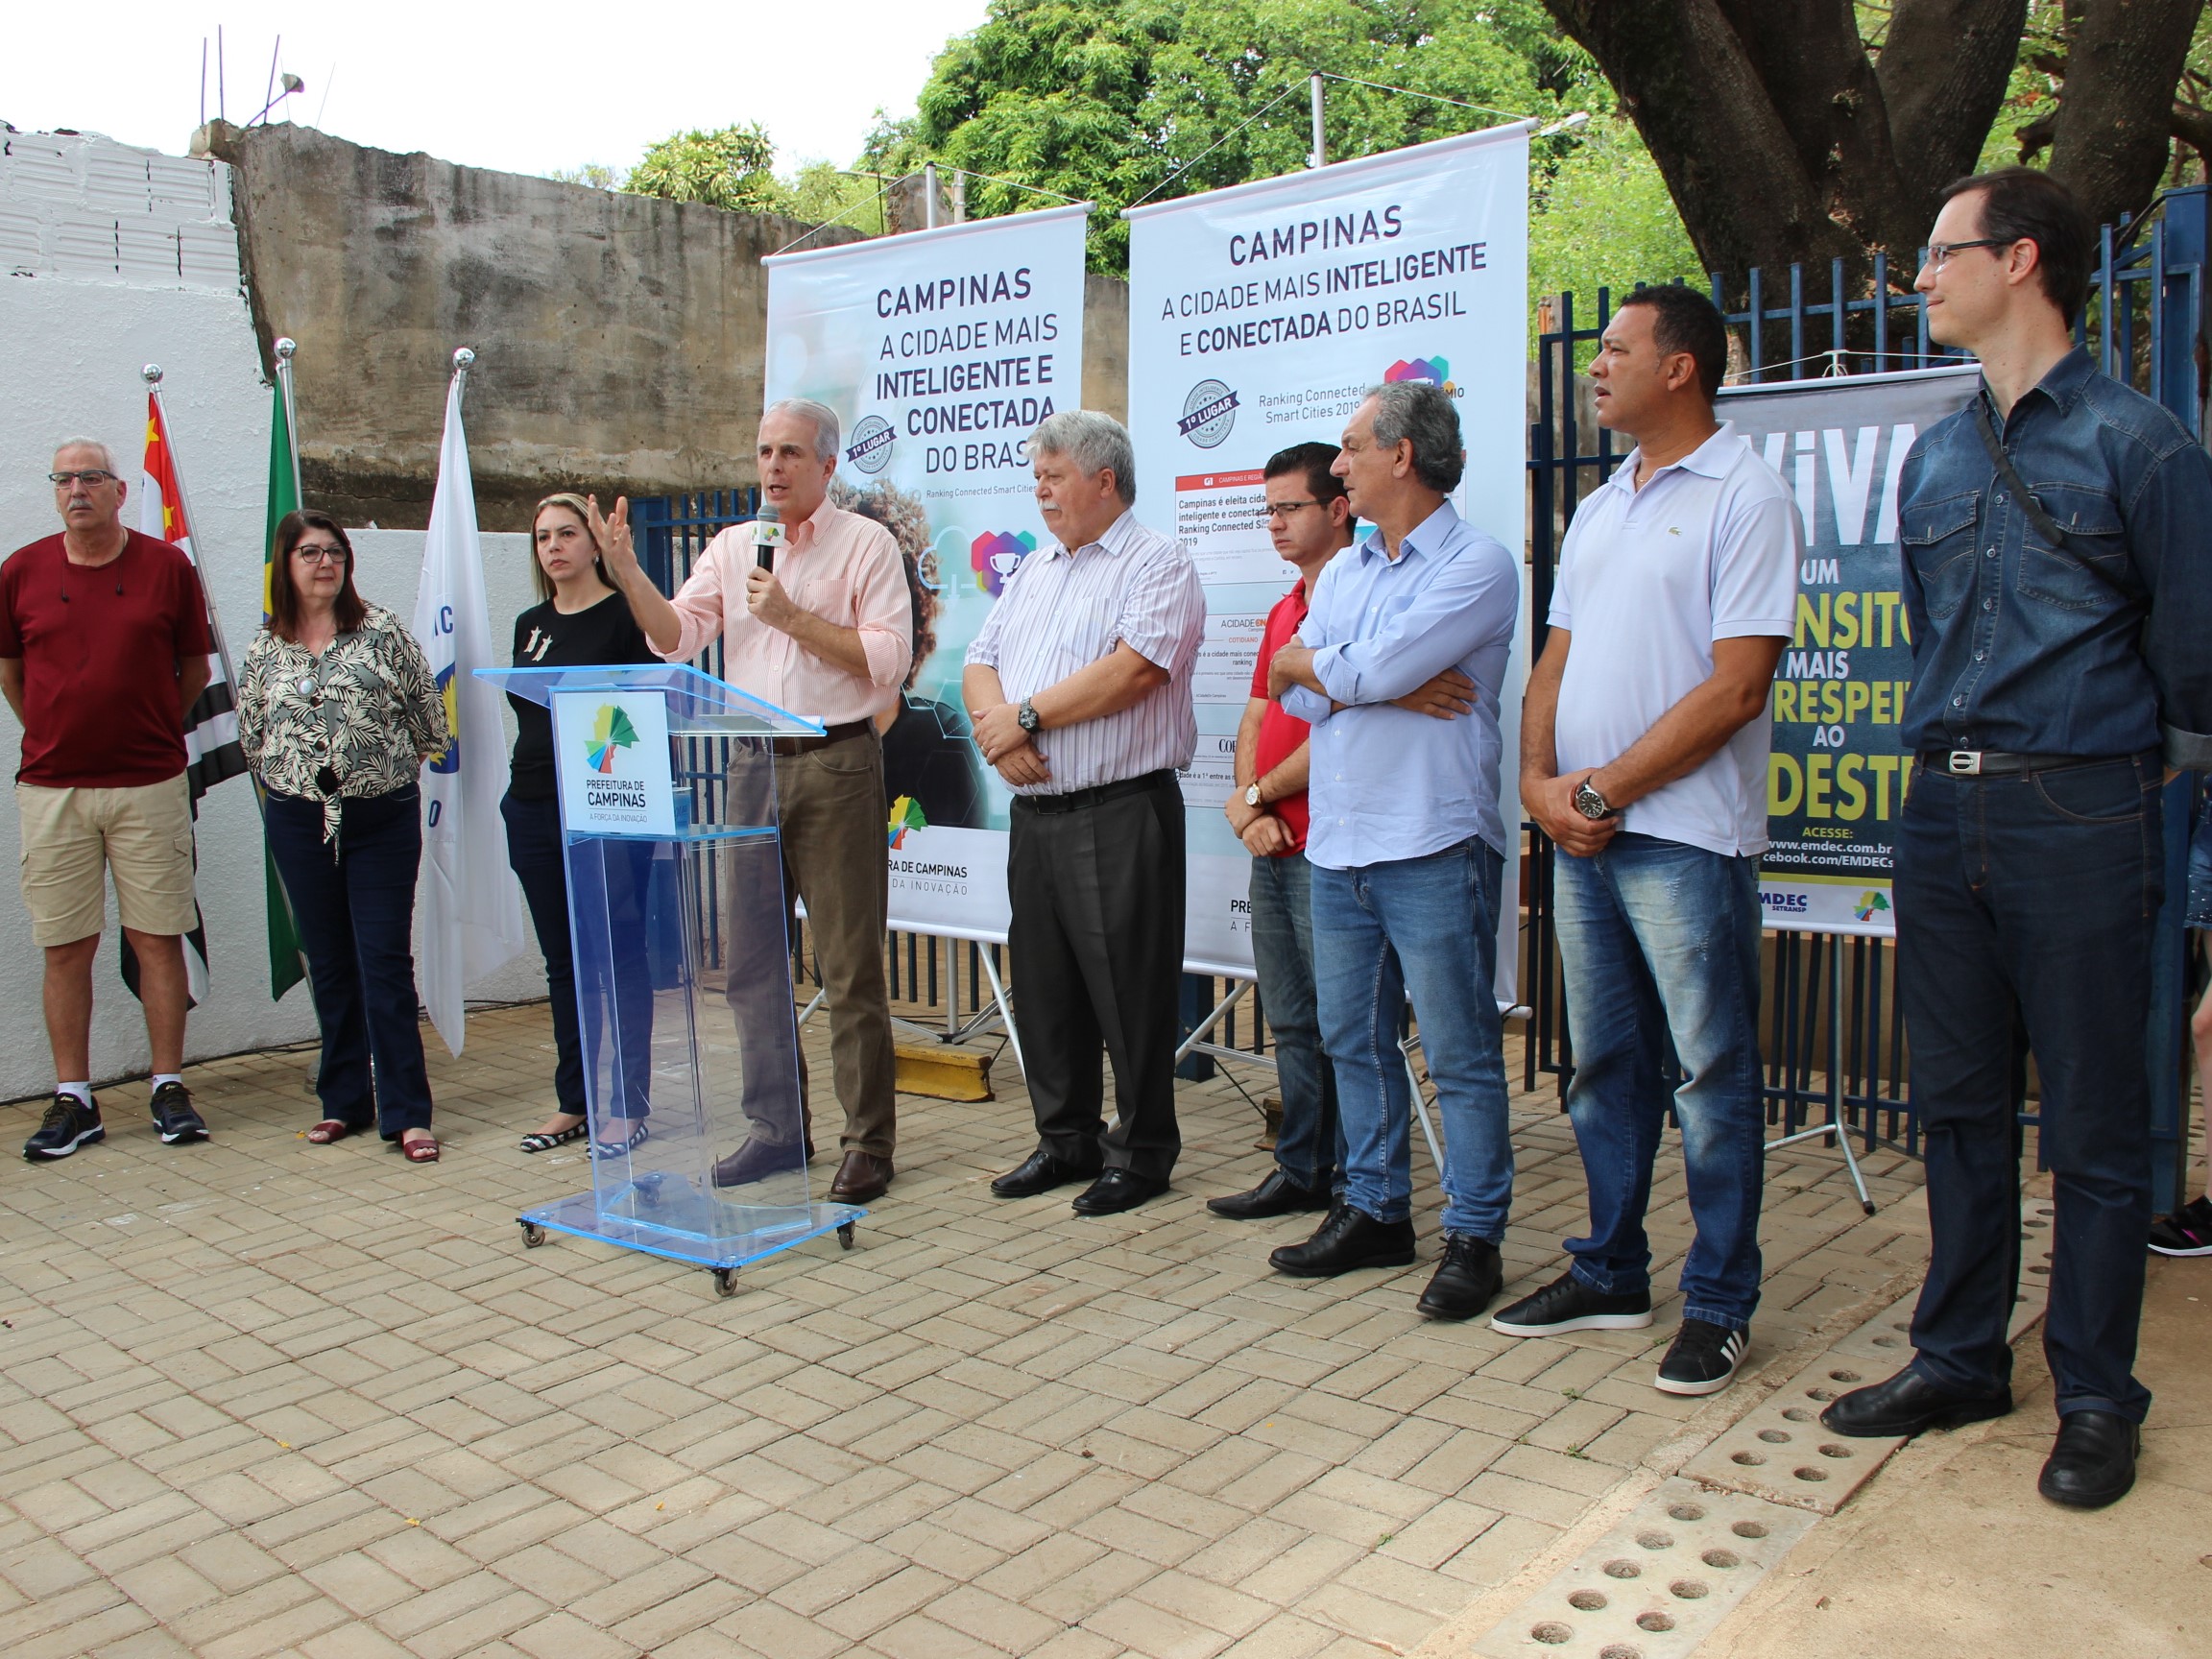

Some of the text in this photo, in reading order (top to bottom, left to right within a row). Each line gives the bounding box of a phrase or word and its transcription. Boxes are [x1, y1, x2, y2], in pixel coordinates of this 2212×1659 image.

[1230, 204, 1402, 266] CAMPINAS
[1162, 242, 1486, 321] A CIDADE MAIS INTELIGENTE
[877, 267, 1031, 318] CAMPINAS
[1181, 291, 1467, 356] E CONECTADA DO BRASIL
[879, 313, 1058, 361] A CIDADE MAIS
[877, 354, 1053, 400] INTELIGENTE E
[1259, 382, 1366, 407] Ranking Connected
[1444, 387, 1465, 398] MIO
[906, 396, 1055, 436] CONECTADA
[1197, 397, 1233, 424] LUGAR
[1265, 409, 1299, 424] Smart
[1302, 405, 1334, 420] Cities
[862, 431, 891, 453] LUGAR
[926, 440, 1030, 473] DO BRAS
[1218, 475, 1243, 484] CAMPINAS
[926, 489, 954, 499] Ranking
[954, 486, 992, 497] Connected
[993, 485, 1016, 494] Smart
[1178, 493, 1266, 510] Campinas é eleita cida
[1178, 510, 1220, 522] inteligente
[1178, 523, 1210, 535] Ranking
[1212, 520, 1254, 532] Connected
[1800, 558, 1839, 586] UM
[1787, 590, 1911, 650] NSIT
[1786, 650, 1850, 680] MAIS
[1773, 680, 1911, 725] RESPEI
[1812, 725, 1845, 748] AO
[586, 779, 645, 791] PREFEITURA DE
[1767, 752, 1914, 821] DEST
[588, 791, 646, 807] CAMPINAS
[594, 812, 613, 822] FORÇA
[613, 813, 620, 822] DA
[620, 814, 648, 824] INOVAÇÃO
[1801, 827, 1854, 839] ACESSE:
[1767, 839, 1893, 854] www.emdec.com.br
[888, 859, 968, 878] RA DE CAMPINAS
[1763, 851, 1894, 868] cebook.com/EMDECs
[892, 878, 968, 897] DA INOVAÇÃO
[1231, 899, 1251, 914] PRE
[1758, 892, 1808, 907] MDEC
[1771, 904, 1807, 913] SETRANSP
[1230, 921, 1238, 931] A
